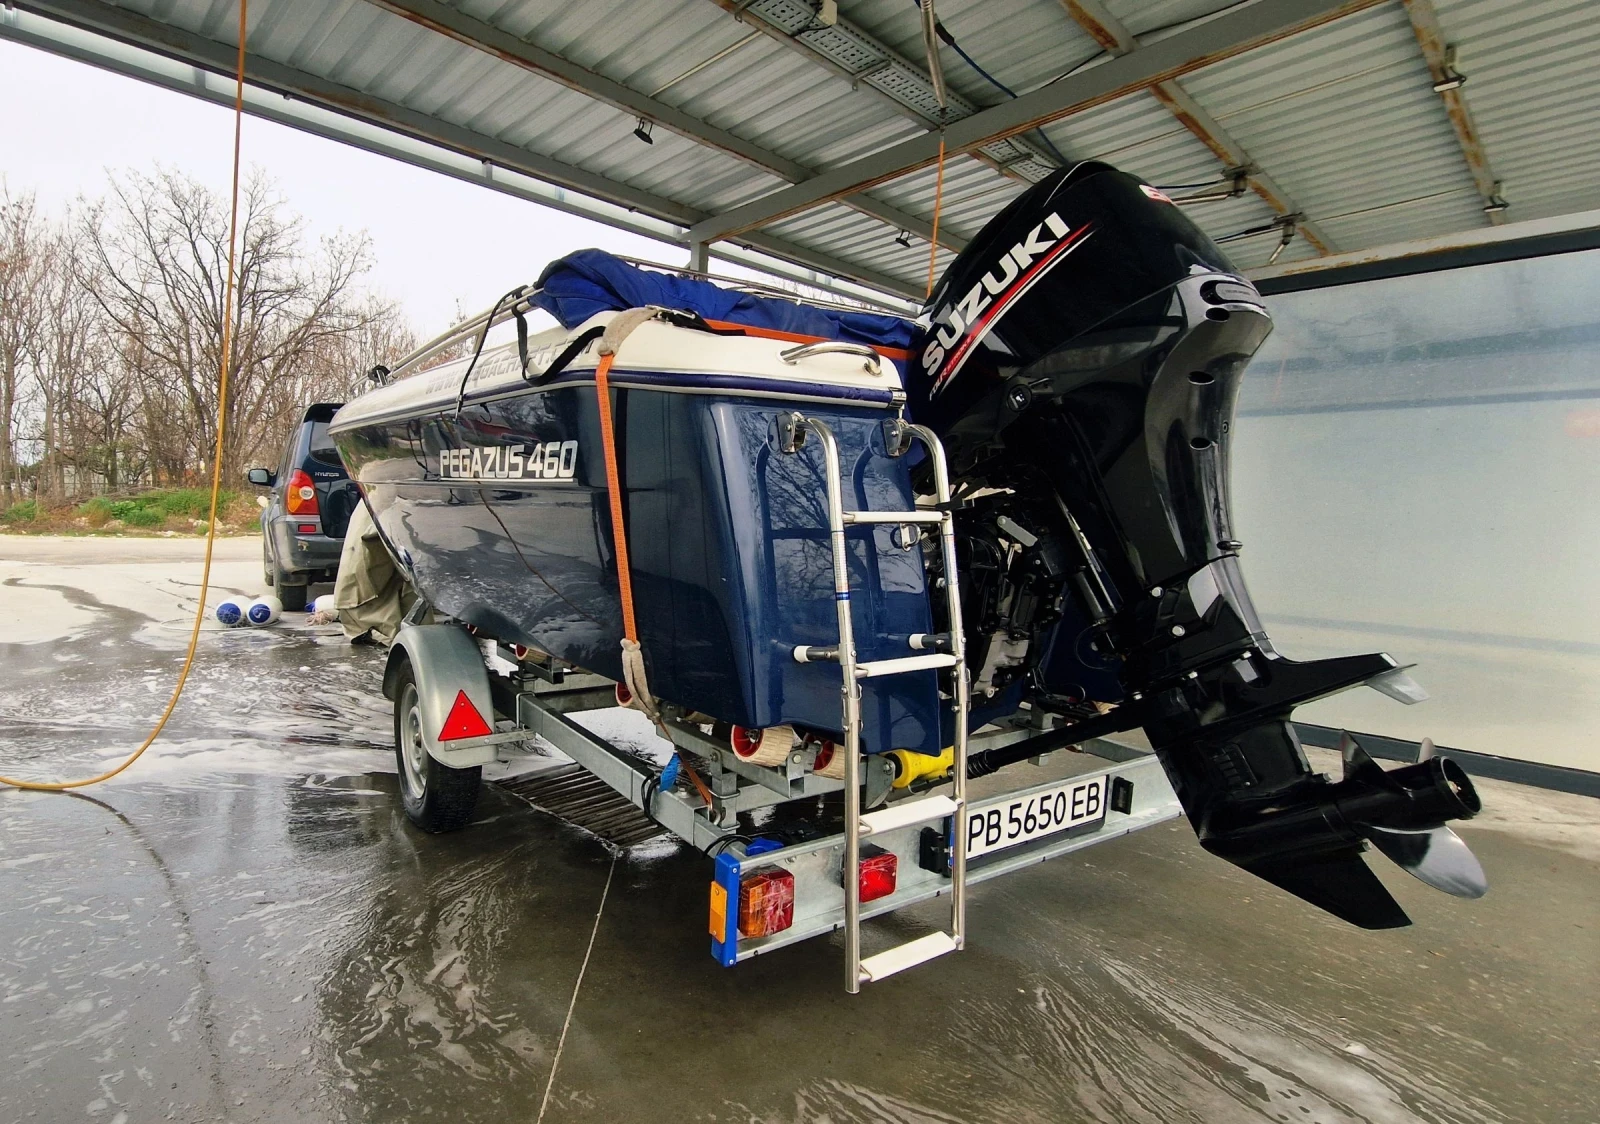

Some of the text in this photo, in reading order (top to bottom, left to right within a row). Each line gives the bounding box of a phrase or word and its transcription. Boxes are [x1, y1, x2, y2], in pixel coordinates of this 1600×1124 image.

[922, 211, 1070, 376] SUZUKI
[440, 440, 578, 479] PEGAZUS 460
[967, 782, 1100, 852] PB 5650 EB
